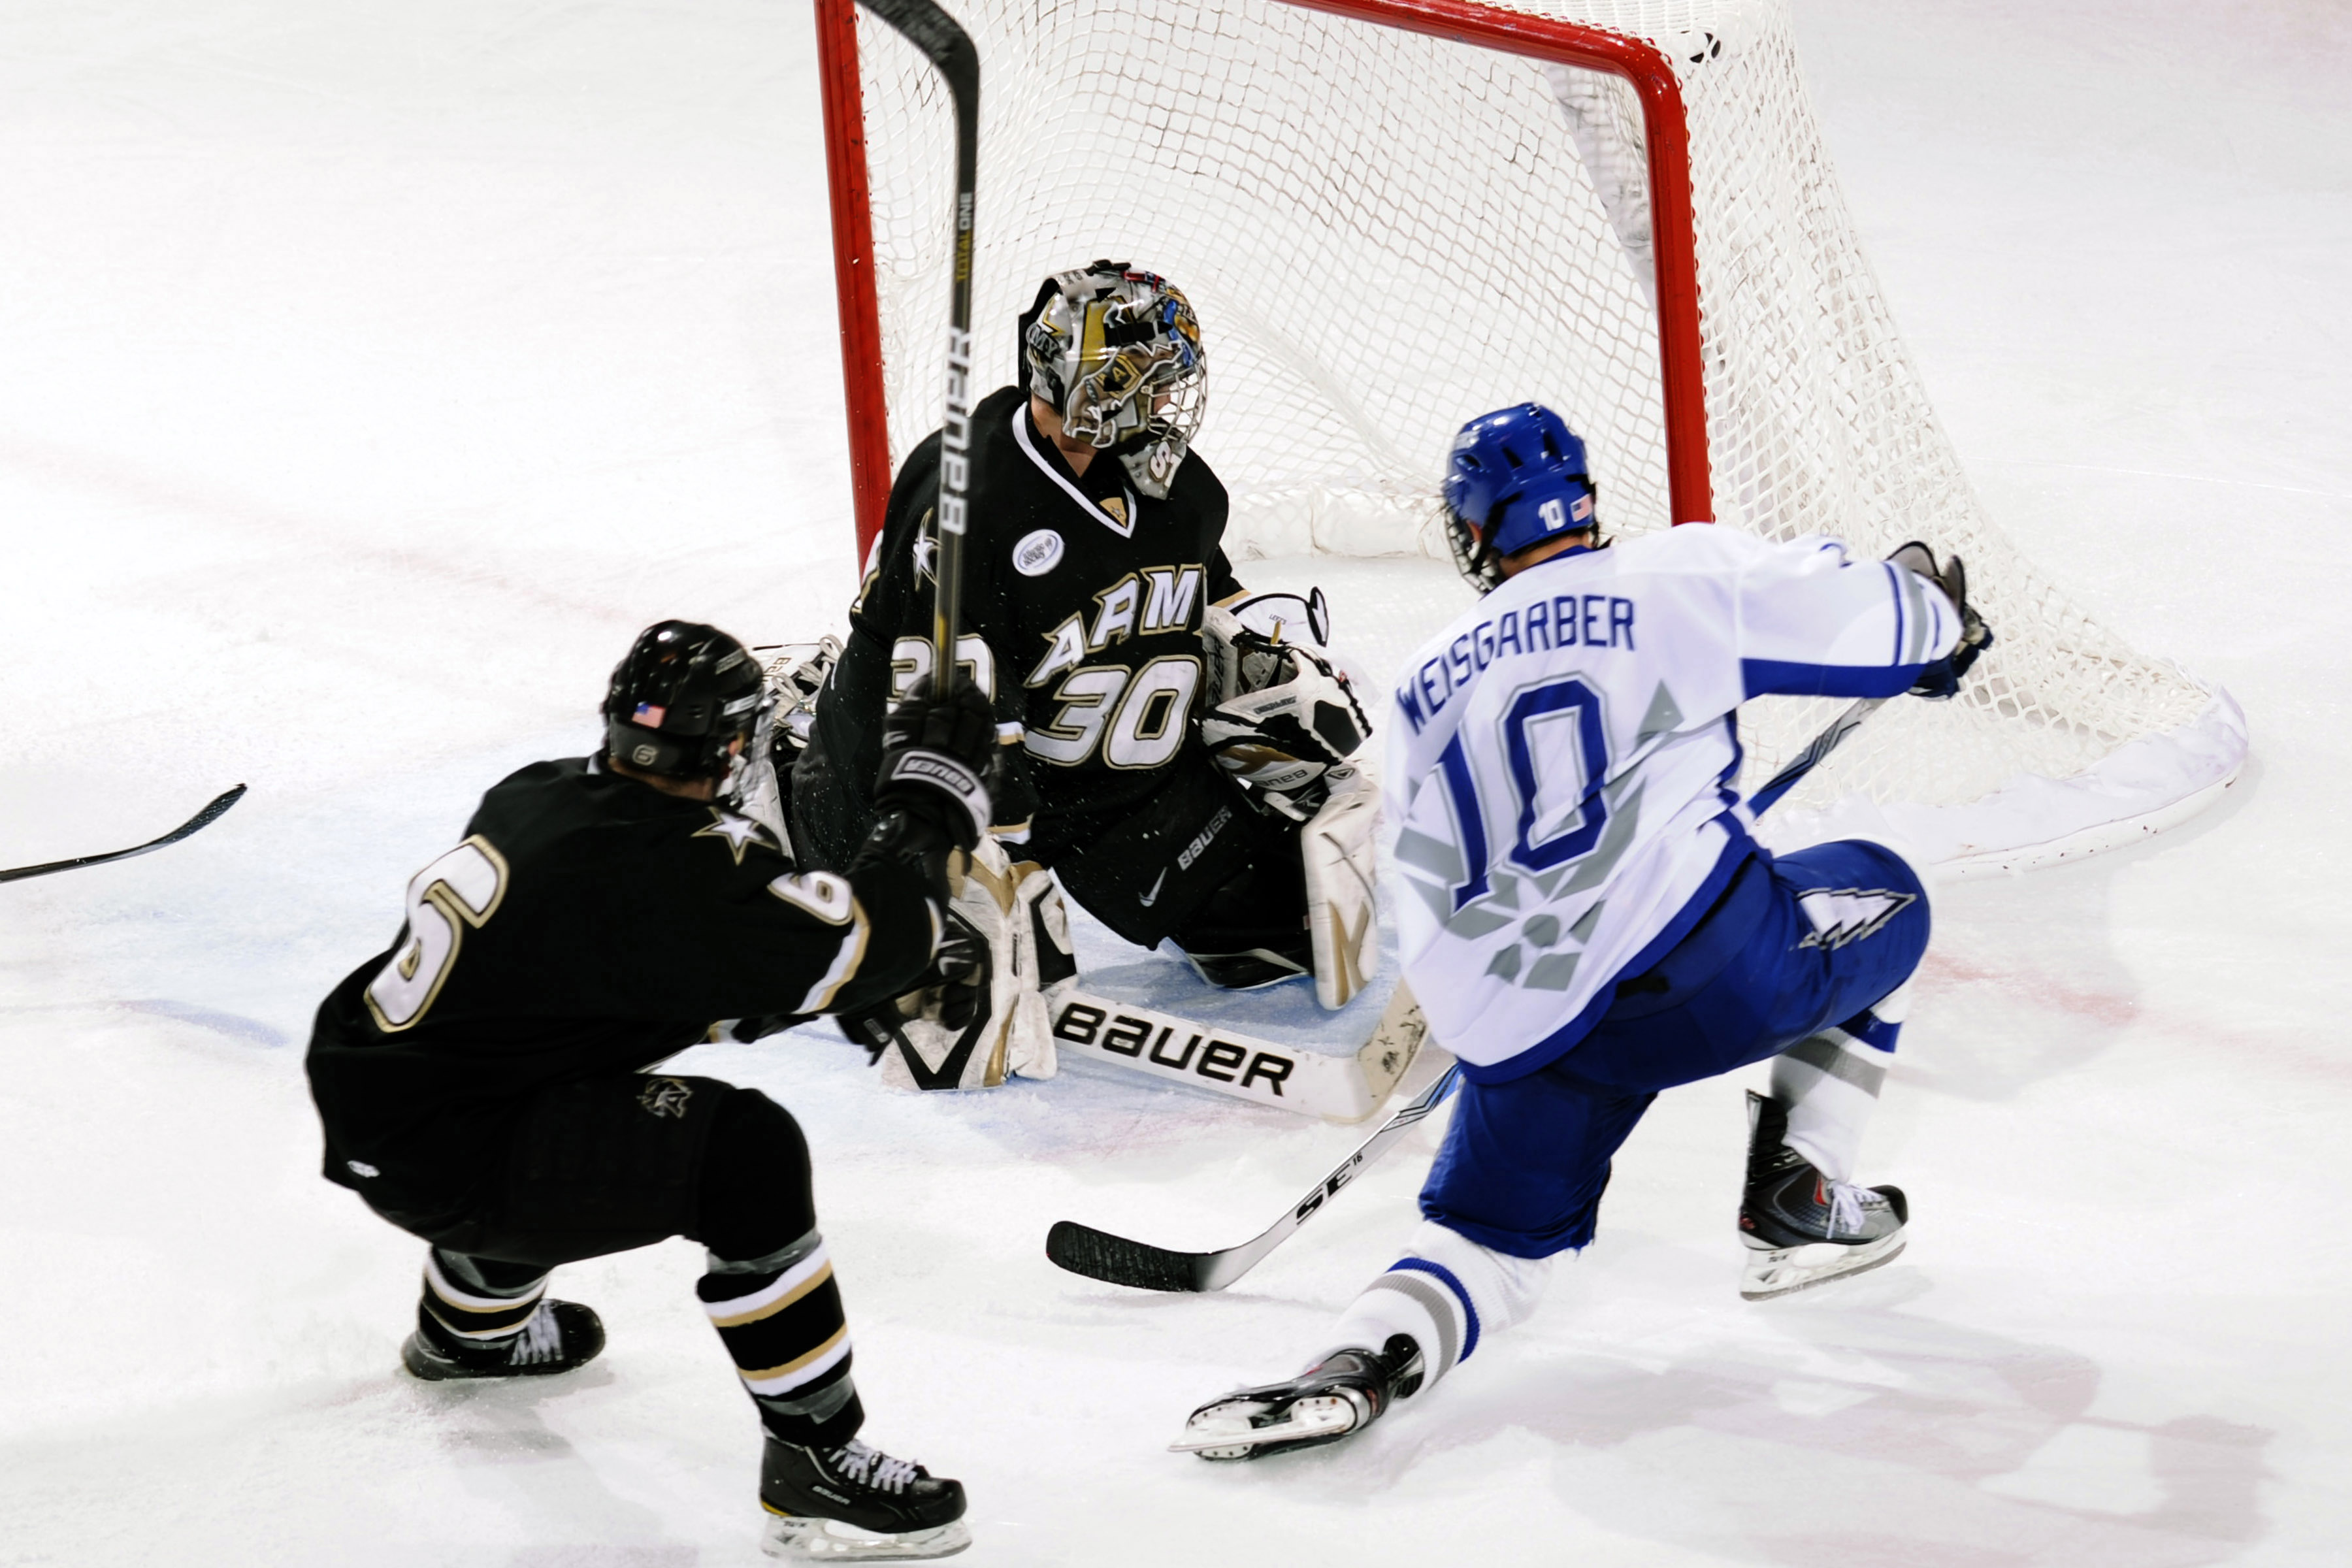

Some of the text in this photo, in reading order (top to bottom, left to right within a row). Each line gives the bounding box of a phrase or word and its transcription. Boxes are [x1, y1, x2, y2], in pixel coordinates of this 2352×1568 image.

[958, 192, 973, 231] ONE
[1537, 498, 1566, 531] 10
[1023, 563, 1209, 689] ARM
[1396, 595, 1635, 736] WEISGARBER
[1023, 655, 1201, 770] 30
[632, 744, 658, 766] 6
[1433, 671, 1614, 915] 10
[1177, 805, 1232, 871] BAUER
[363, 834, 510, 1034] 6
[767, 870, 856, 926] 6
[1053, 1002, 1294, 1097] BAUER
[1296, 1151, 1363, 1225] SE 16
